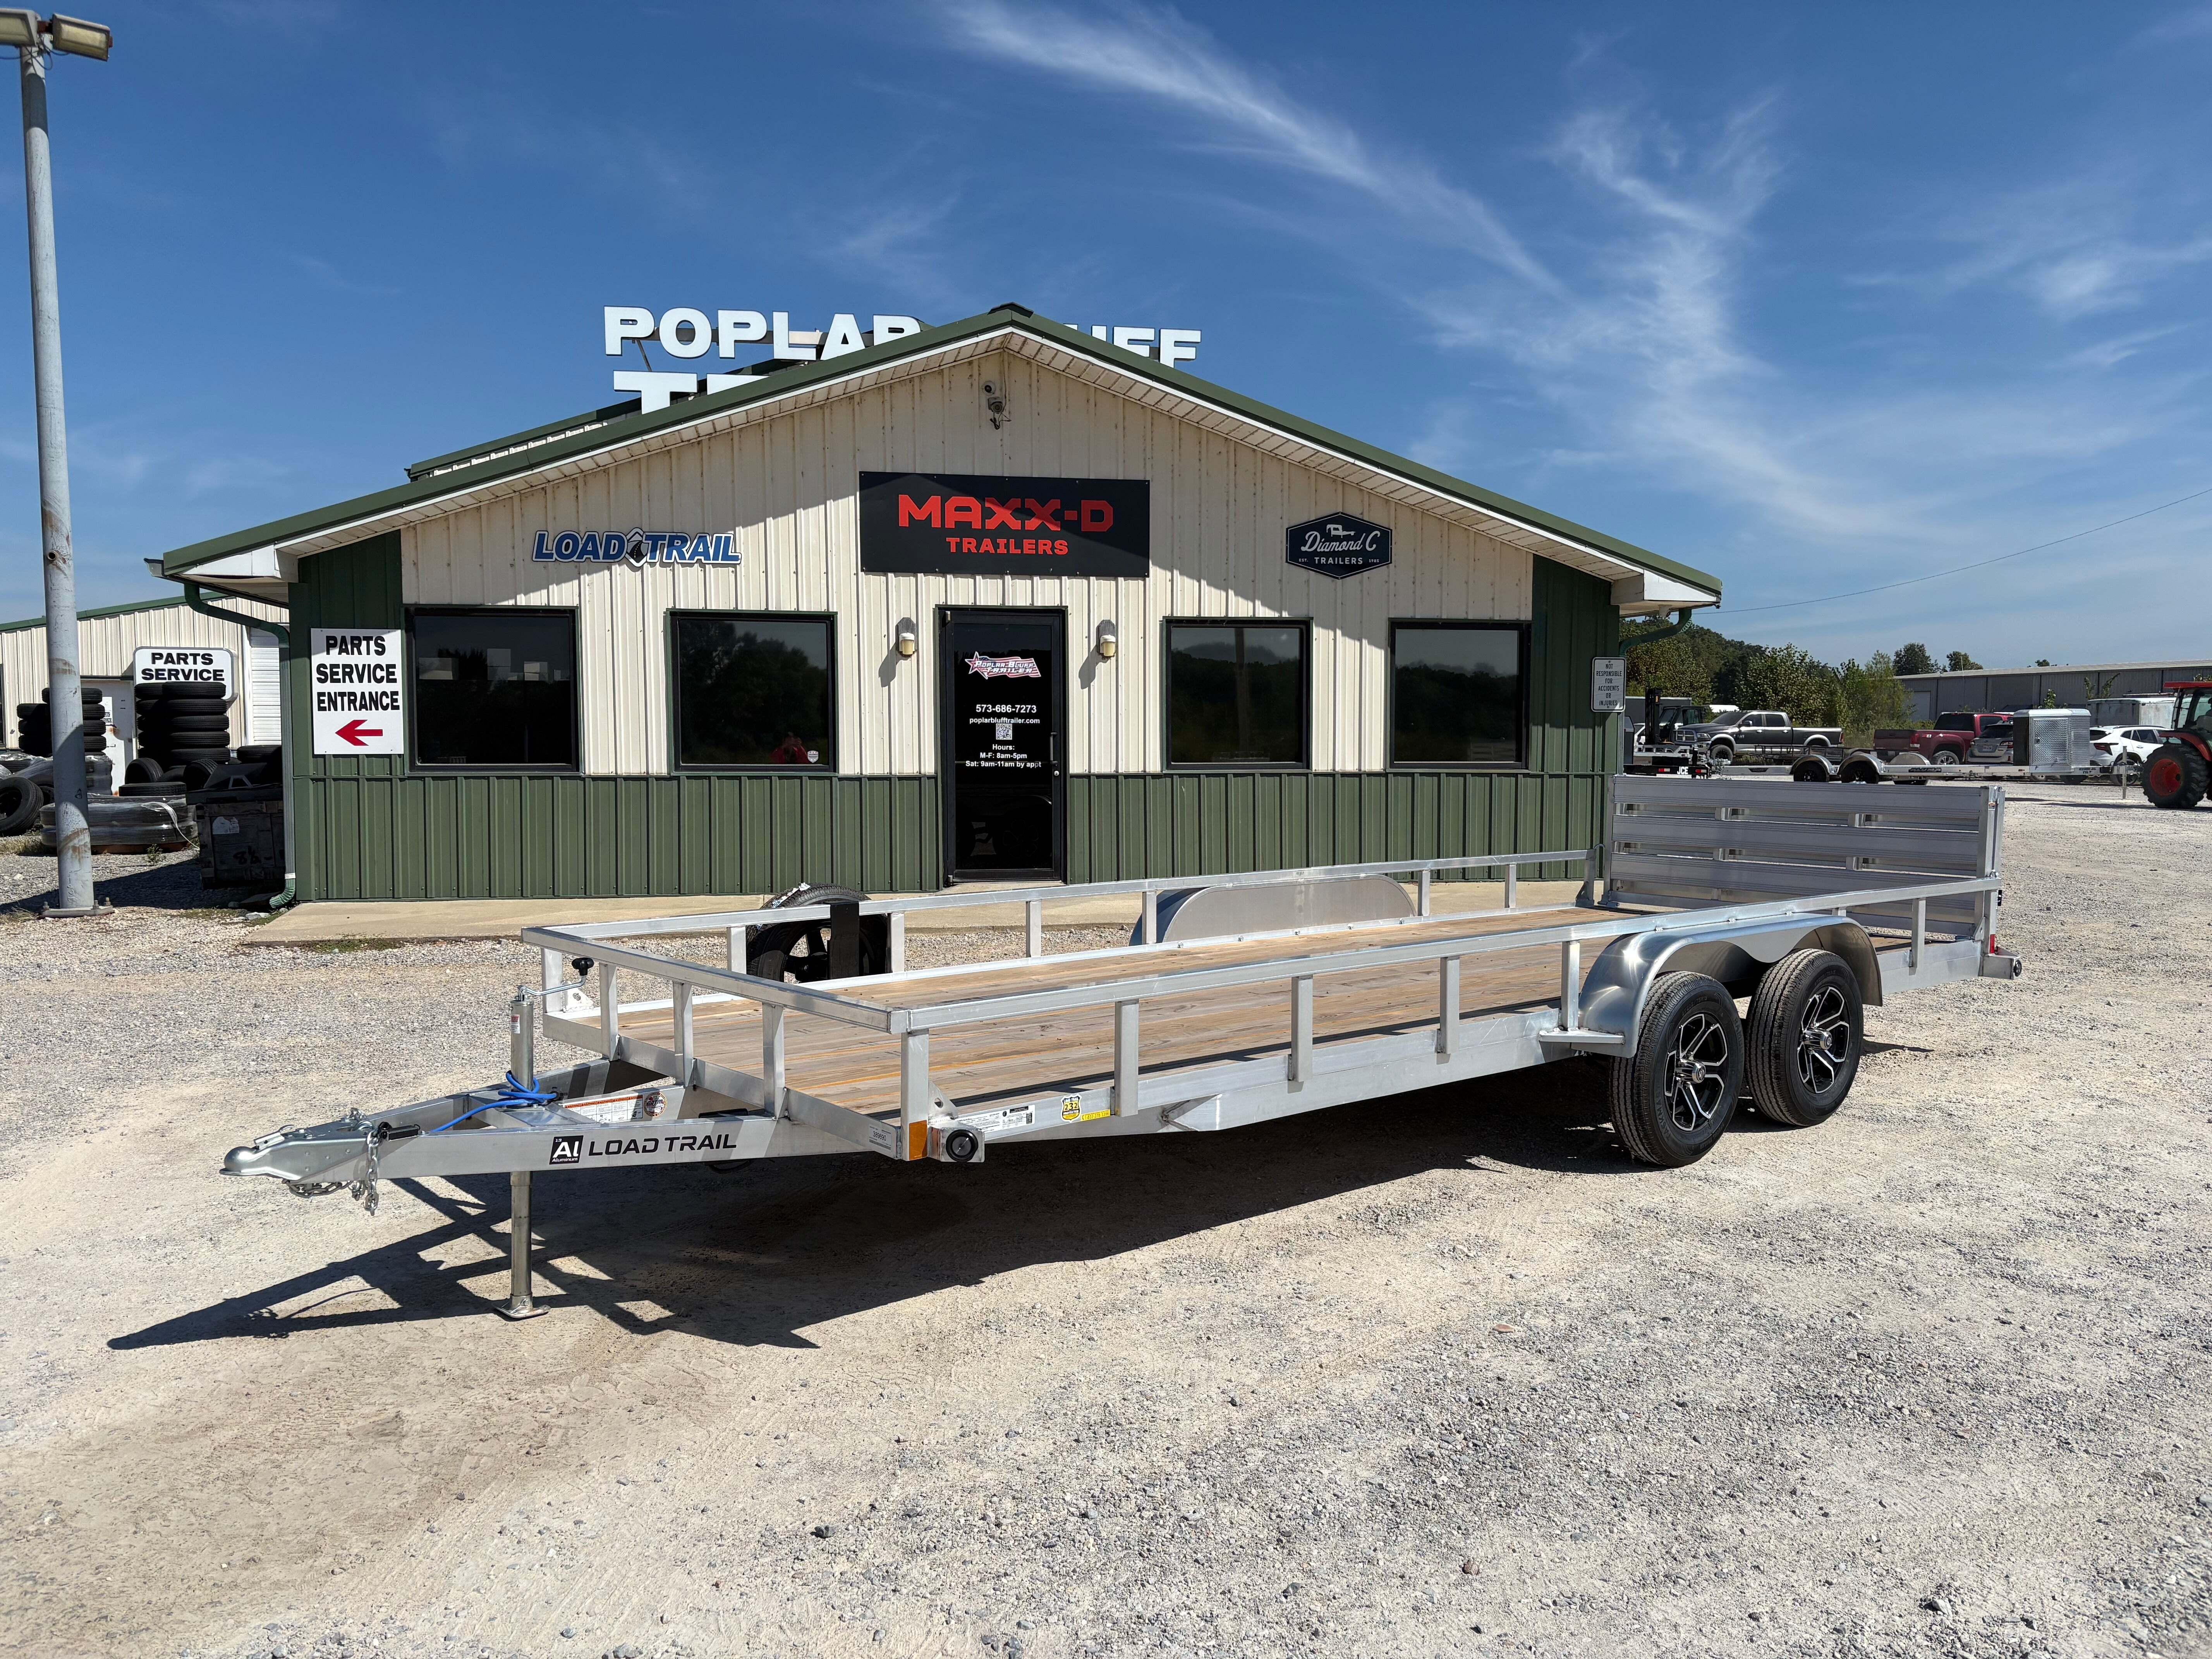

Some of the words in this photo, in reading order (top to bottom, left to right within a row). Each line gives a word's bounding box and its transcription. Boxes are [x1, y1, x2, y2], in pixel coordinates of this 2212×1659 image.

[898, 495, 1113, 532] MAXX-D
[533, 531, 627, 561] LOAD
[643, 532, 741, 563] TRAIL
[946, 538, 1068, 555] TRAILERS
[1301, 531, 1366, 551] Diamond
[1365, 531, 1380, 551] C
[326, 635, 386, 656] PARTS
[151, 653, 213, 665] PARTS
[141, 668, 225, 681] SERVICE
[316, 663, 397, 684] SERVICE
[317, 691, 400, 711] ENTRANCE
[976, 704, 1037, 713] 573-686-7273
[1065, 1103, 1078, 1111] 232
[552, 1141, 579, 1158] Al
[588, 1139, 659, 1156] LOAD
[664, 1134, 737, 1152] TRAIL
